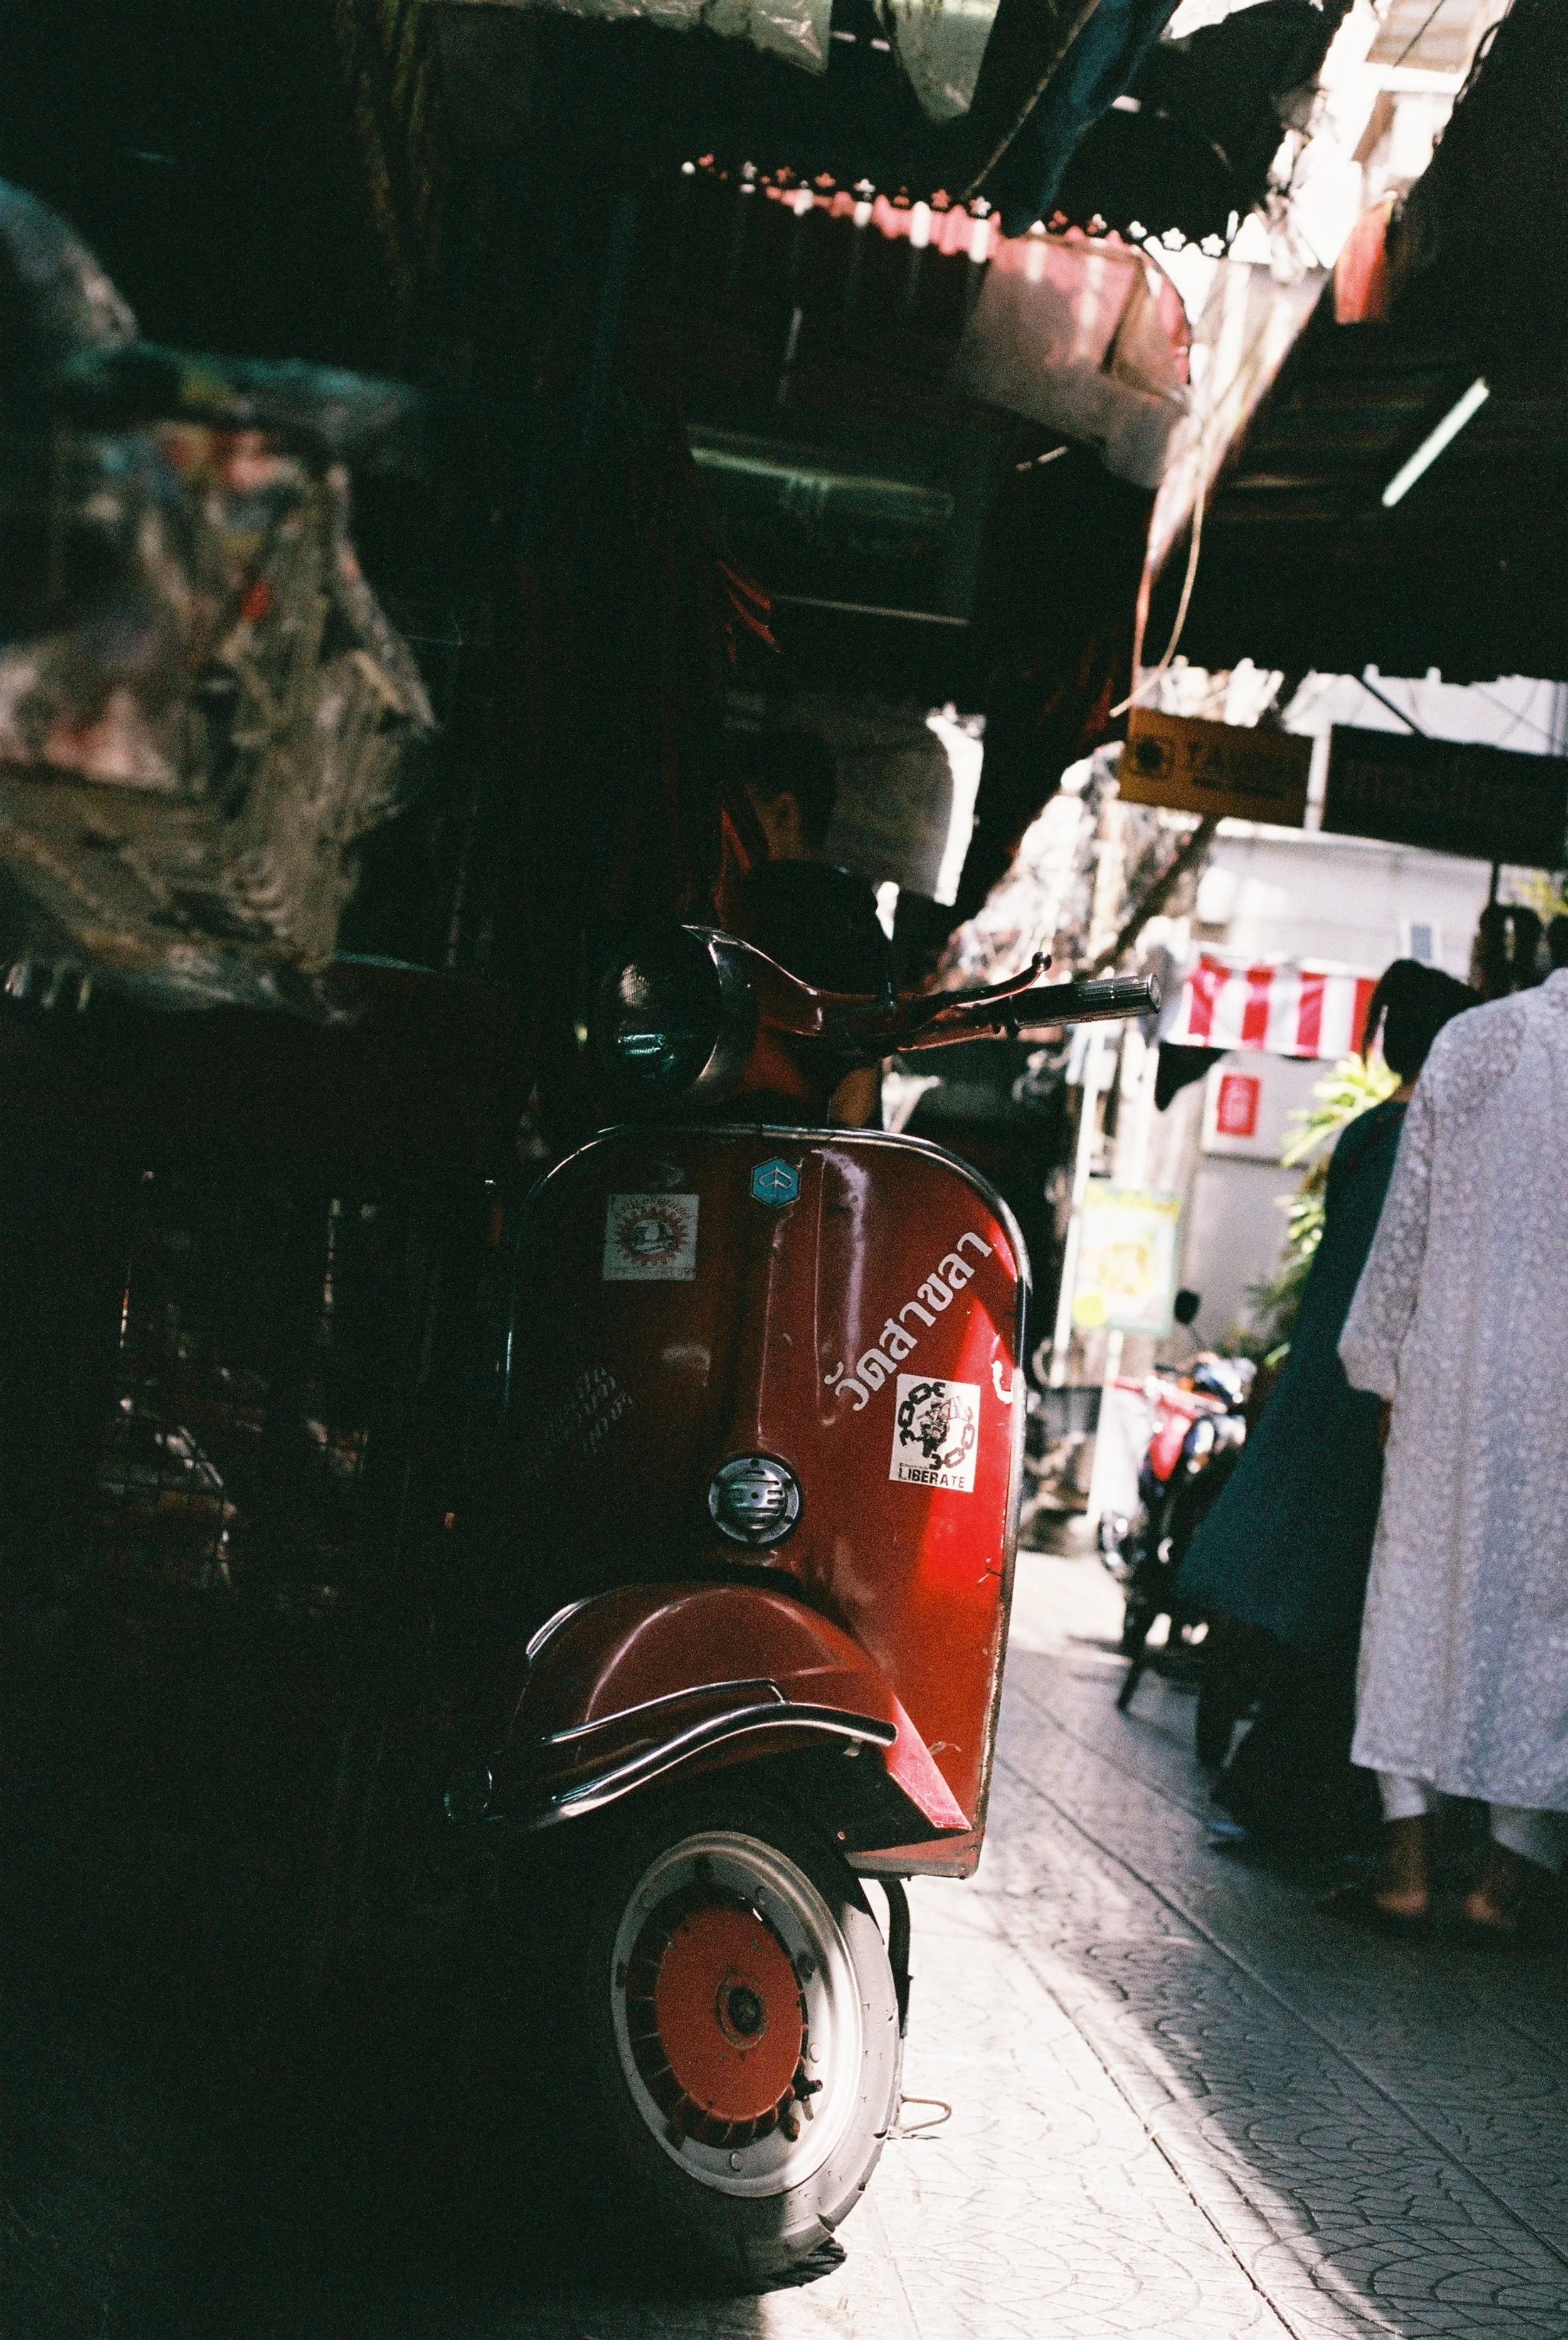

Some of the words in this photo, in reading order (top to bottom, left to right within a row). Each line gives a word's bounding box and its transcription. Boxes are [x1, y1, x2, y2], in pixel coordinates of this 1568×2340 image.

[824, 1231, 993, 1411] วัดสาขลา
[898, 1467, 965, 1489] LIBERATE
